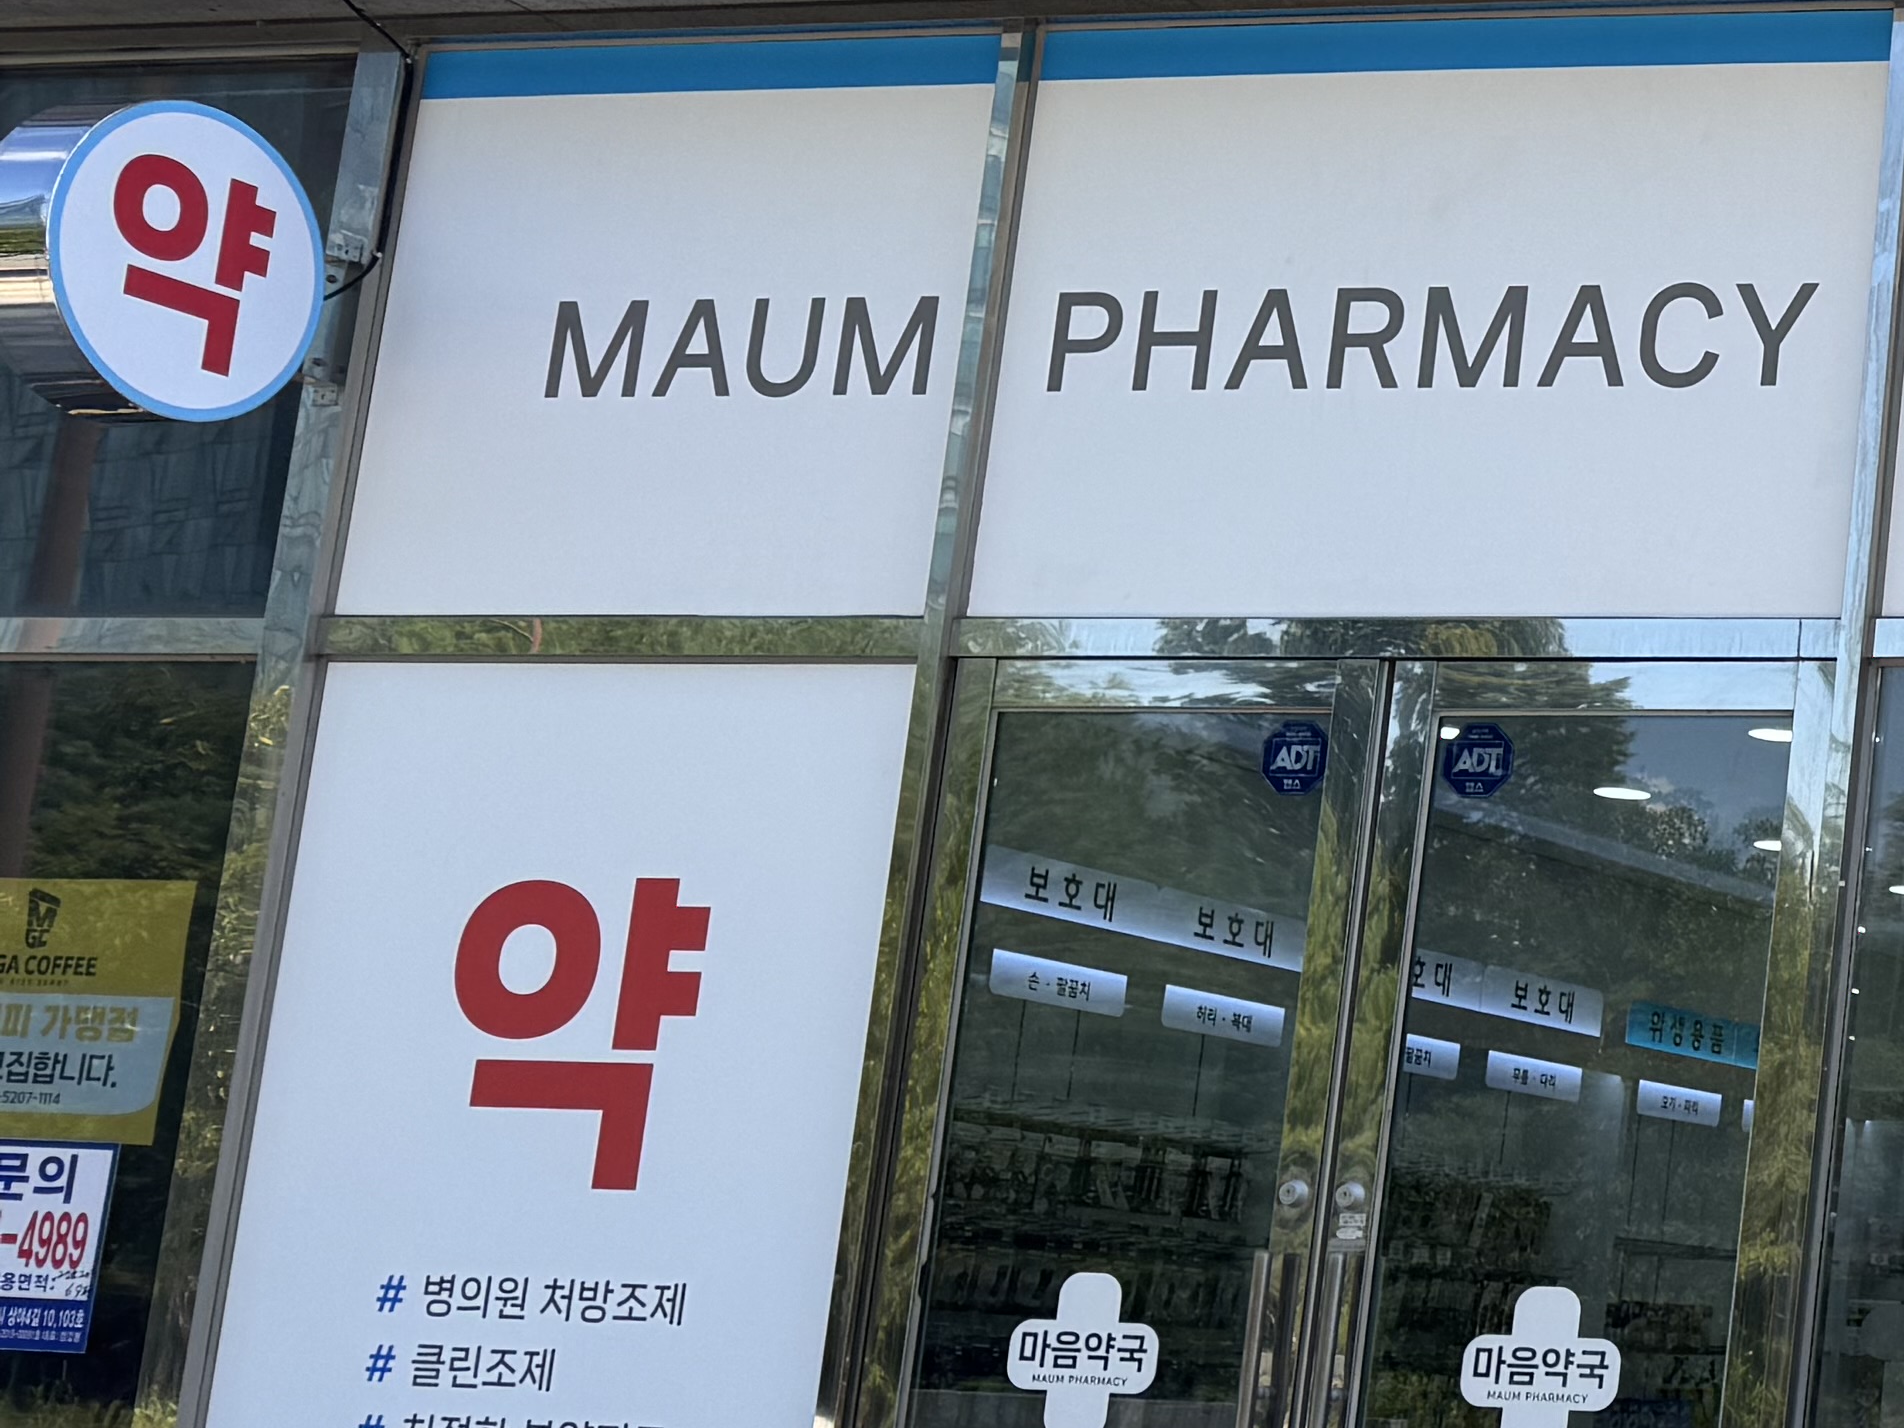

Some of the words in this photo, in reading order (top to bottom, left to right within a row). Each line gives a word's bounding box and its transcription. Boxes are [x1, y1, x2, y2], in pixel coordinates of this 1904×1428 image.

[114, 154, 277, 378] 약
[544, 294, 941, 400] MAUM
[1046, 280, 1819, 392] PHARMACY
[1270, 744, 1321, 771] ADT
[1453, 747, 1504, 775] ADT
[1024, 866, 1117, 923] 보호대
[1193, 906, 1274, 959] 보호대
[25, 956, 97, 976] COFFEE
[1411, 957, 1453, 998] 호대
[1510, 979, 1575, 1025] 보호대
[0, 1002, 32, 1039] 피
[454, 877, 712, 1191] 약
[376, 1274, 406, 1313] #
[422, 1274, 530, 1320] 병의원
[539, 1278, 688, 1326] 처방조제
[365, 1344, 396, 1383] #
[410, 1343, 557, 1392] 클린조제
[1019, 1329, 1150, 1373] 마음약국
[1471, 1345, 1610, 1389] 마음약국
[1031, 1372, 1065, 1385] MAUM
[1068, 1374, 1128, 1388] PHARMACY
[1486, 1389, 1522, 1403] MAUM
[1525, 1390, 1589, 1405] PHARMACY
